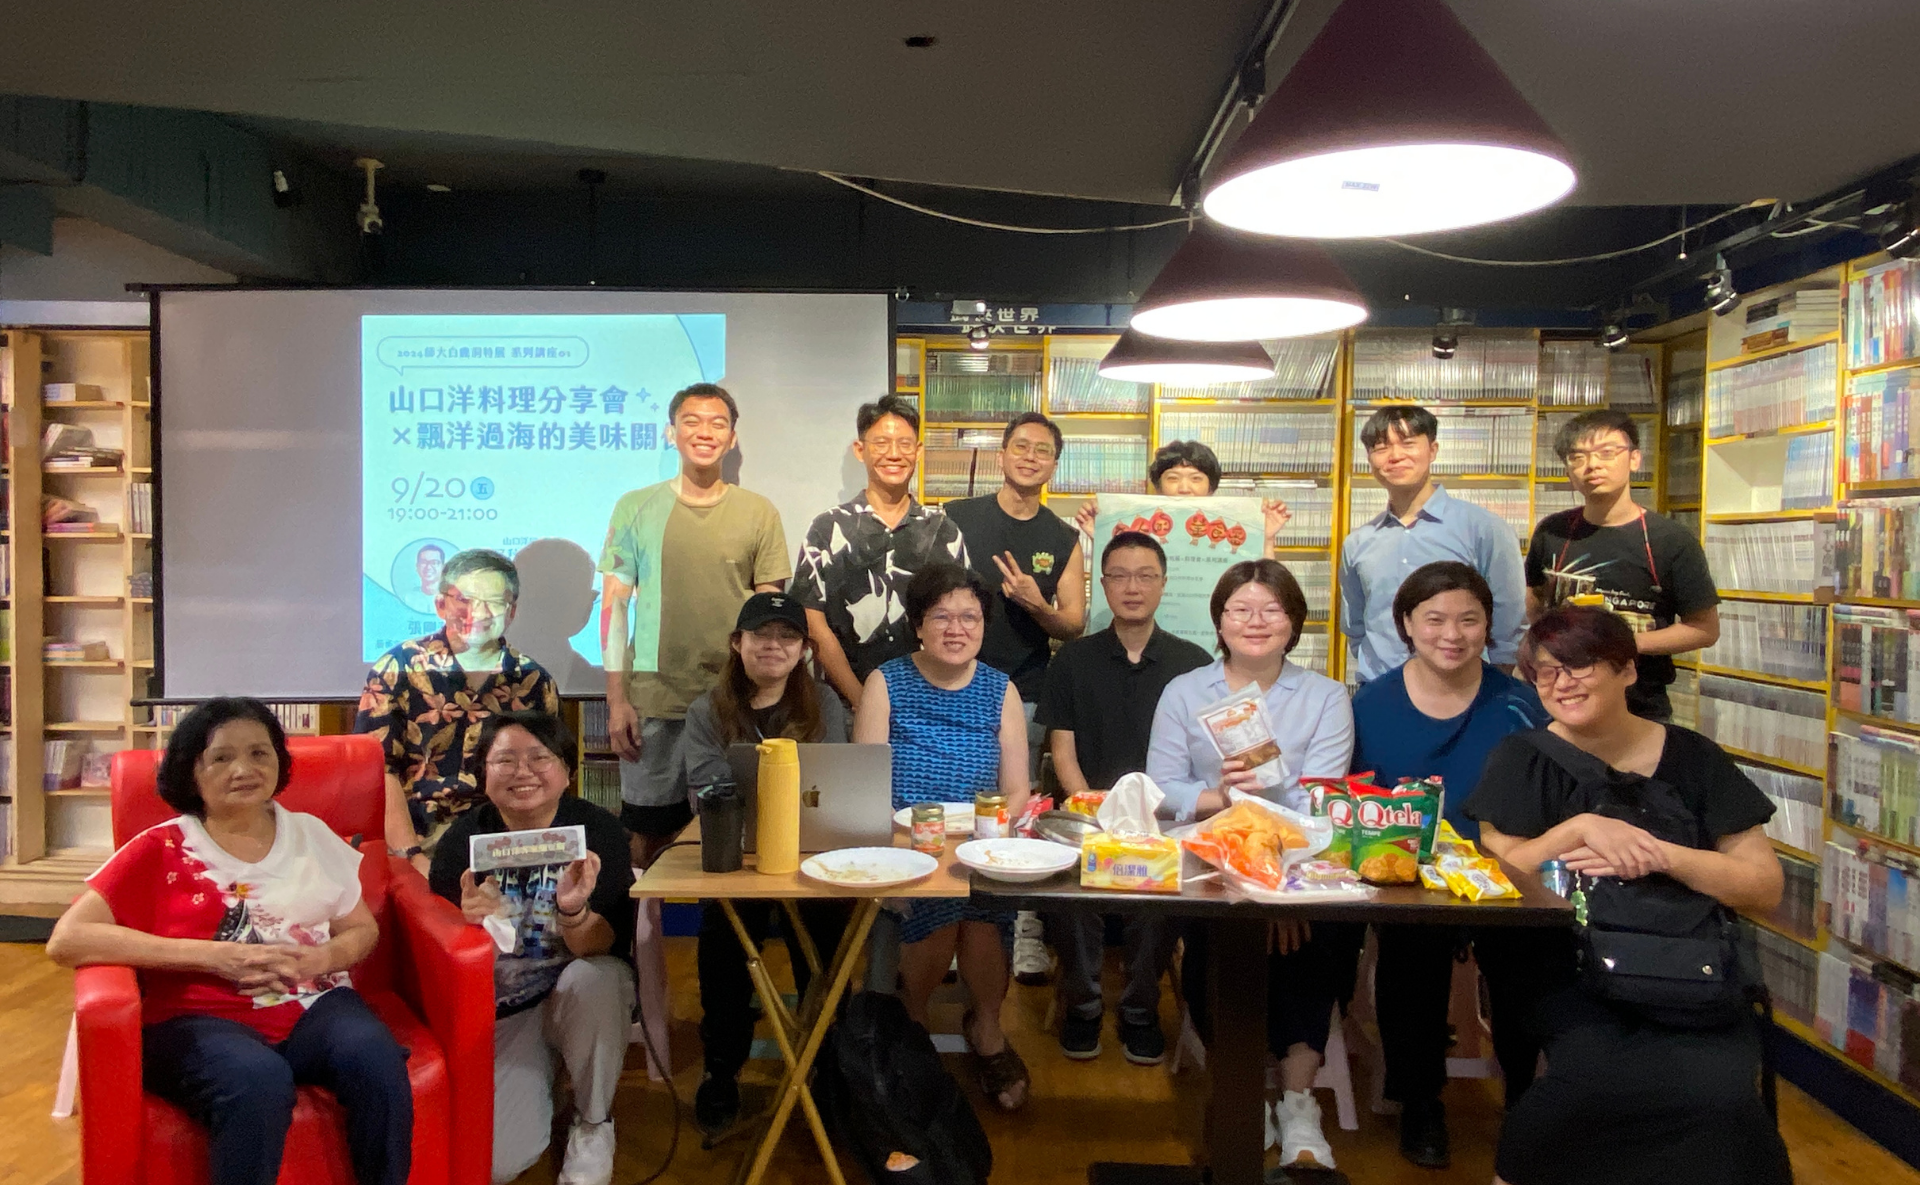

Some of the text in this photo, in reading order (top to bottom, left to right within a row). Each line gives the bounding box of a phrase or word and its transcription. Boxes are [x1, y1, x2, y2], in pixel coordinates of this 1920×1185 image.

[389, 384, 628, 414] 山口洋料理分享會
[391, 471, 465, 505] 9/20
[387, 507, 498, 523] 19:00-21:00
[1604, 596, 1656, 610] NGAPORE
[1358, 800, 1422, 829] Qtela
